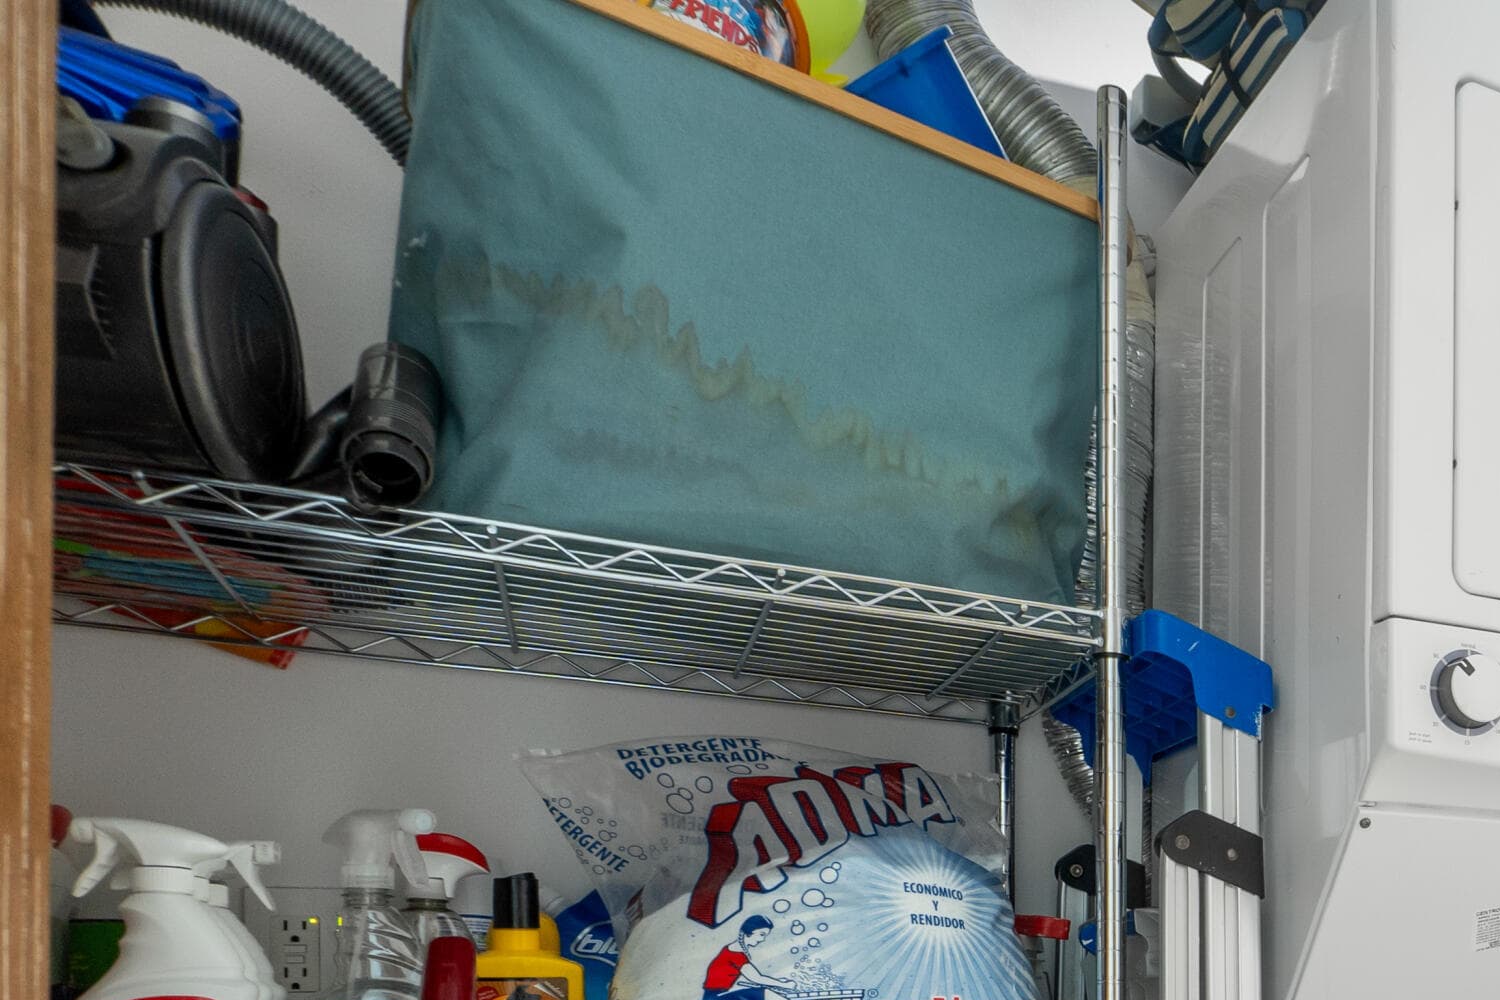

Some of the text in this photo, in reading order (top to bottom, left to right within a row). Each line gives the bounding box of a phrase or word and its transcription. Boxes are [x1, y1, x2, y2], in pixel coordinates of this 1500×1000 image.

[616, 738, 762, 760] DETERGENTE
[625, 748, 808, 780] BIODEGRADA
[903, 881, 963, 900] ECONÓMICO
[932, 900, 939, 911] Y
[910, 913, 965, 930] RENDIDOR
